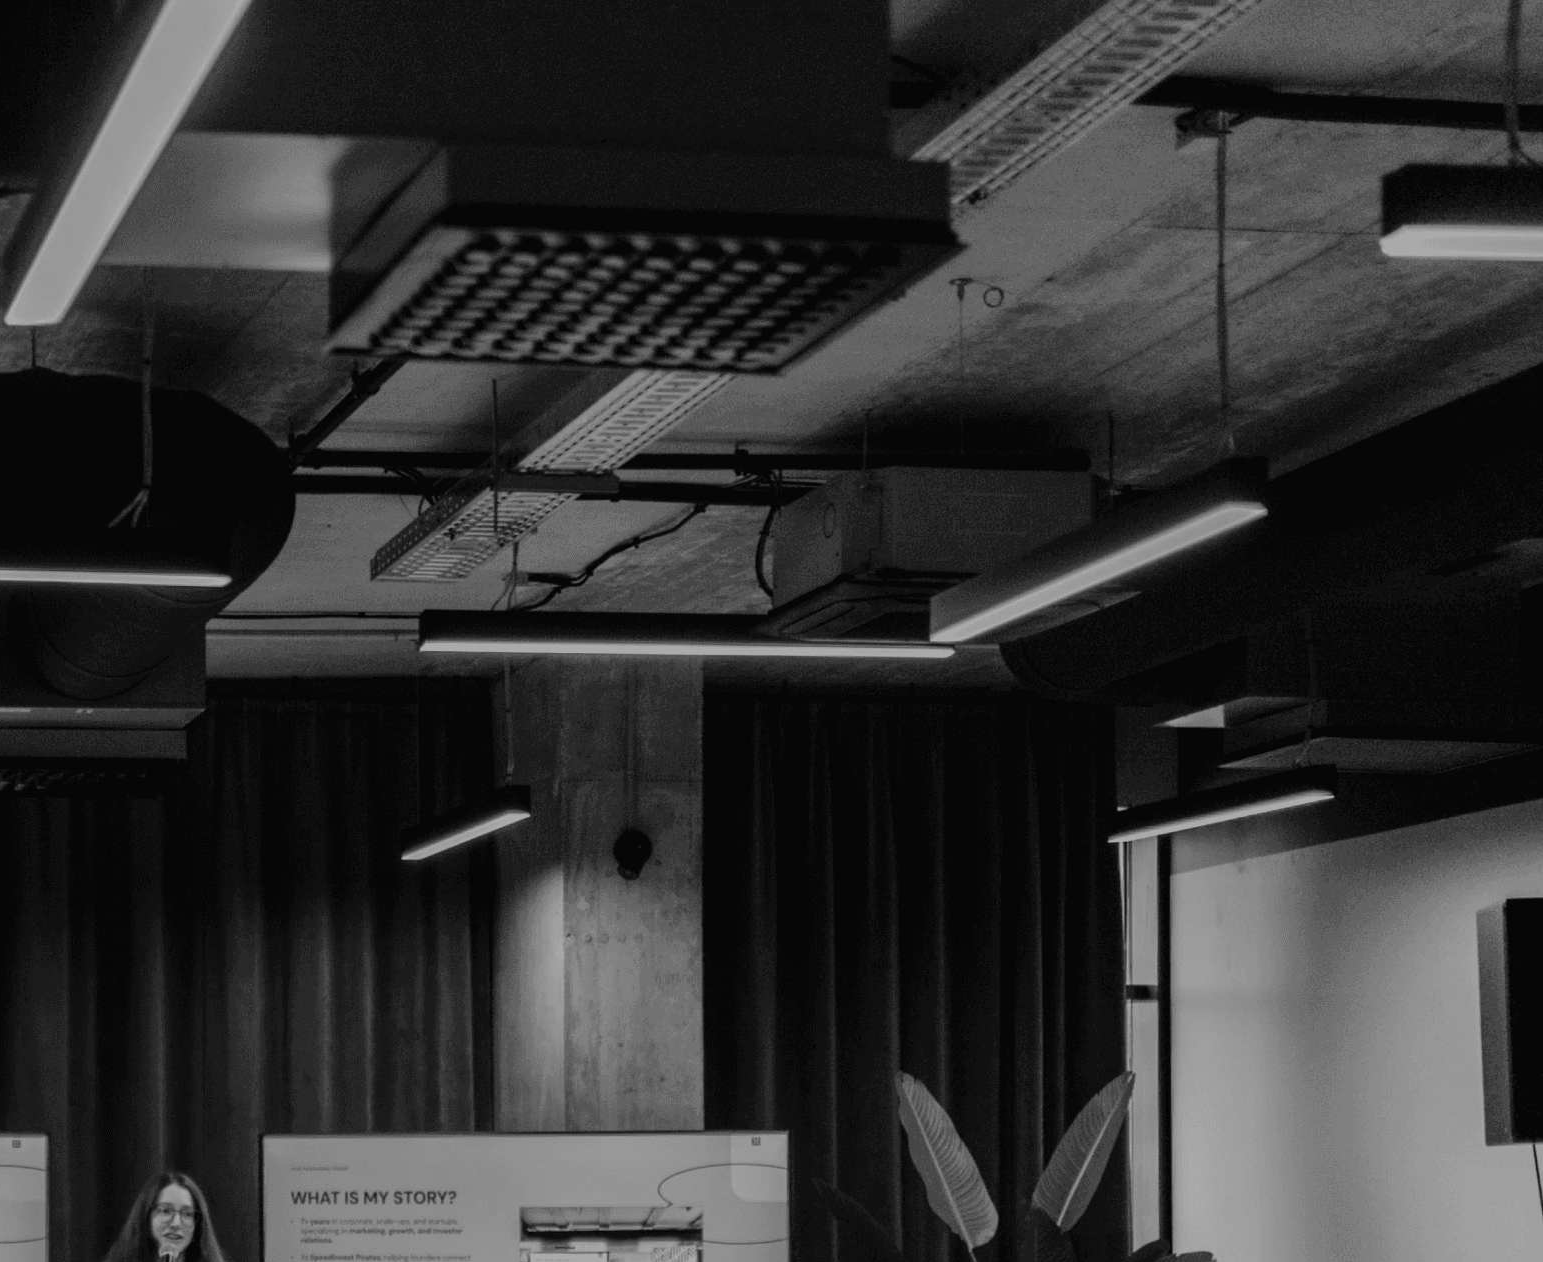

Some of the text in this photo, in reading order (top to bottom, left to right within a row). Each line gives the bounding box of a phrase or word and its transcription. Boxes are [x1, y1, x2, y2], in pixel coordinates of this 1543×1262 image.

[291, 1191, 457, 1205] WHAT IS MY STORY?
